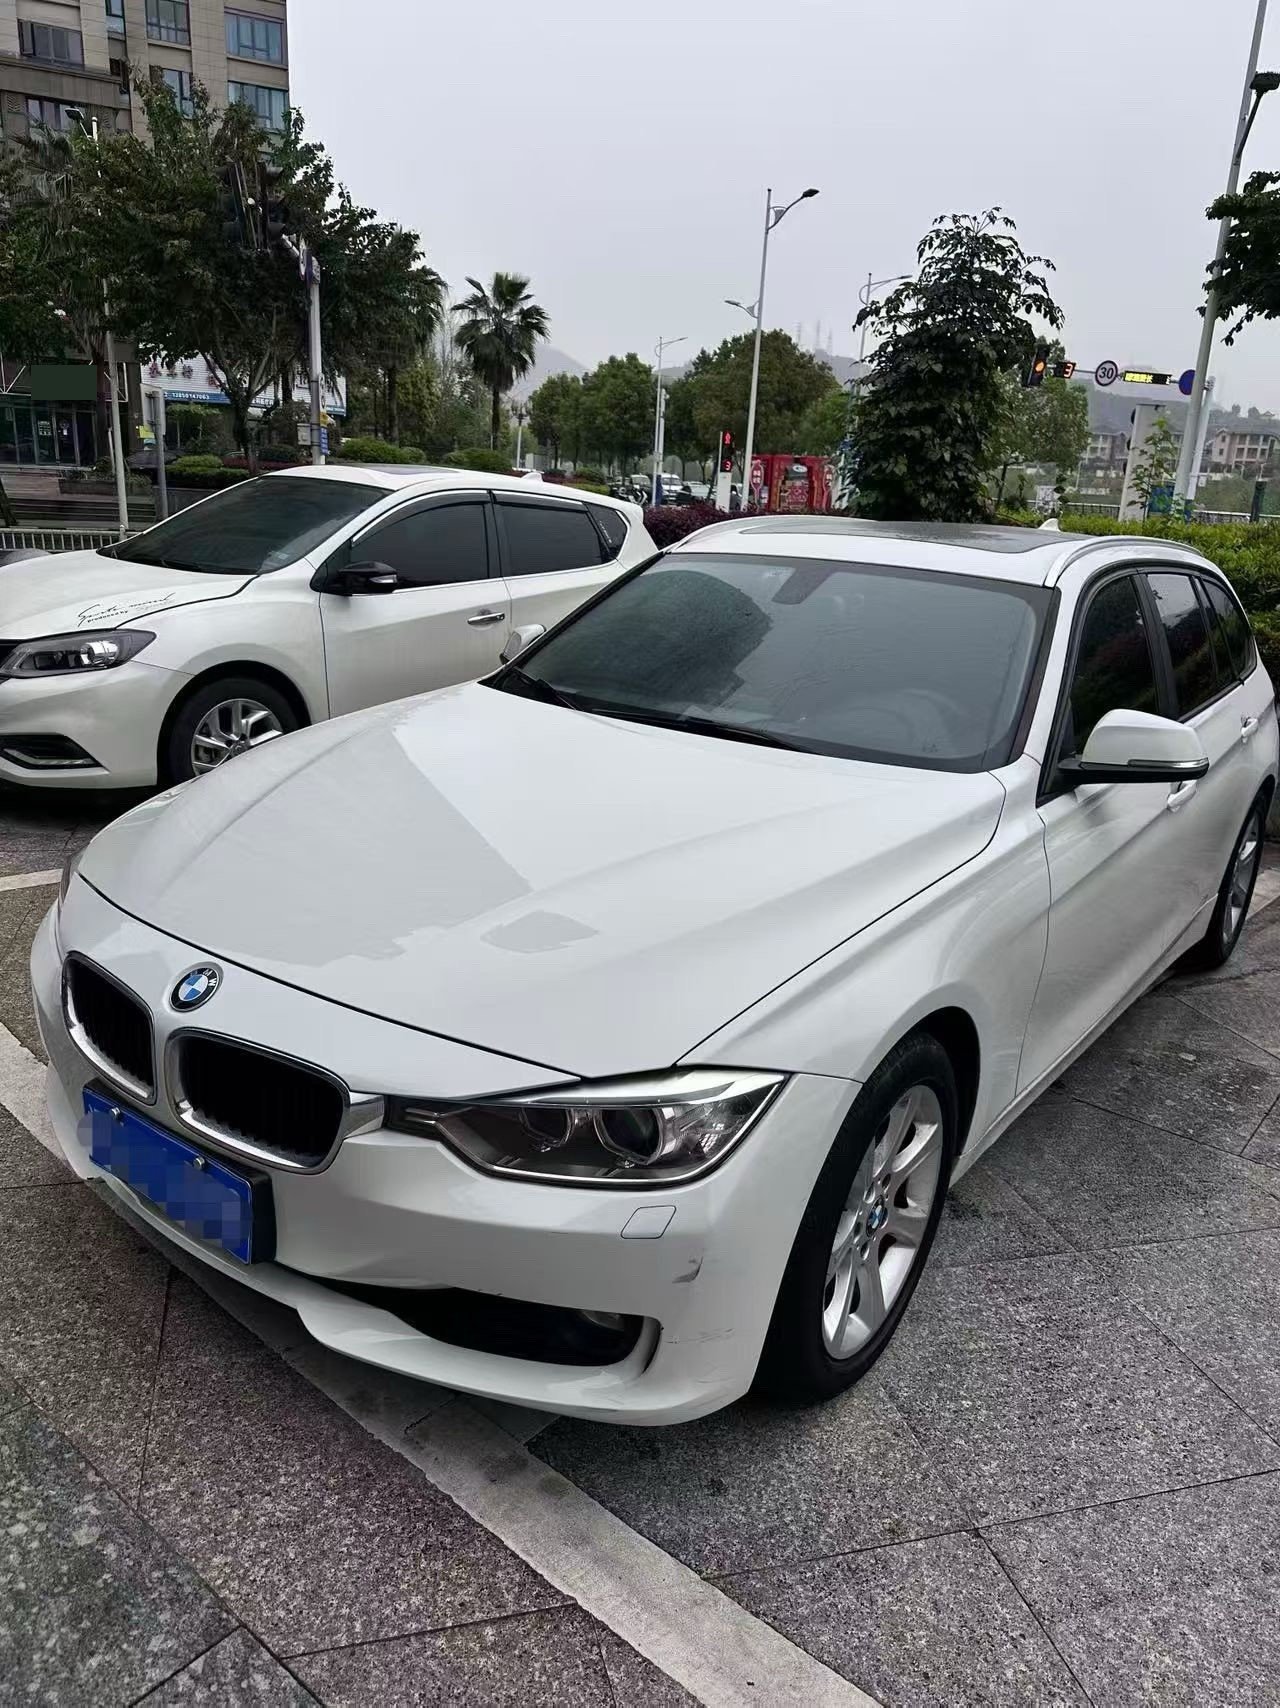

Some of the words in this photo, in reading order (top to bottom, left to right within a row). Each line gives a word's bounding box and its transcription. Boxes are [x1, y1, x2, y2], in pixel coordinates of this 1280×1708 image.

[1063, 363, 1073, 378] 3
[1099, 366, 1114, 380] 30
[725, 460, 731, 471] 3
